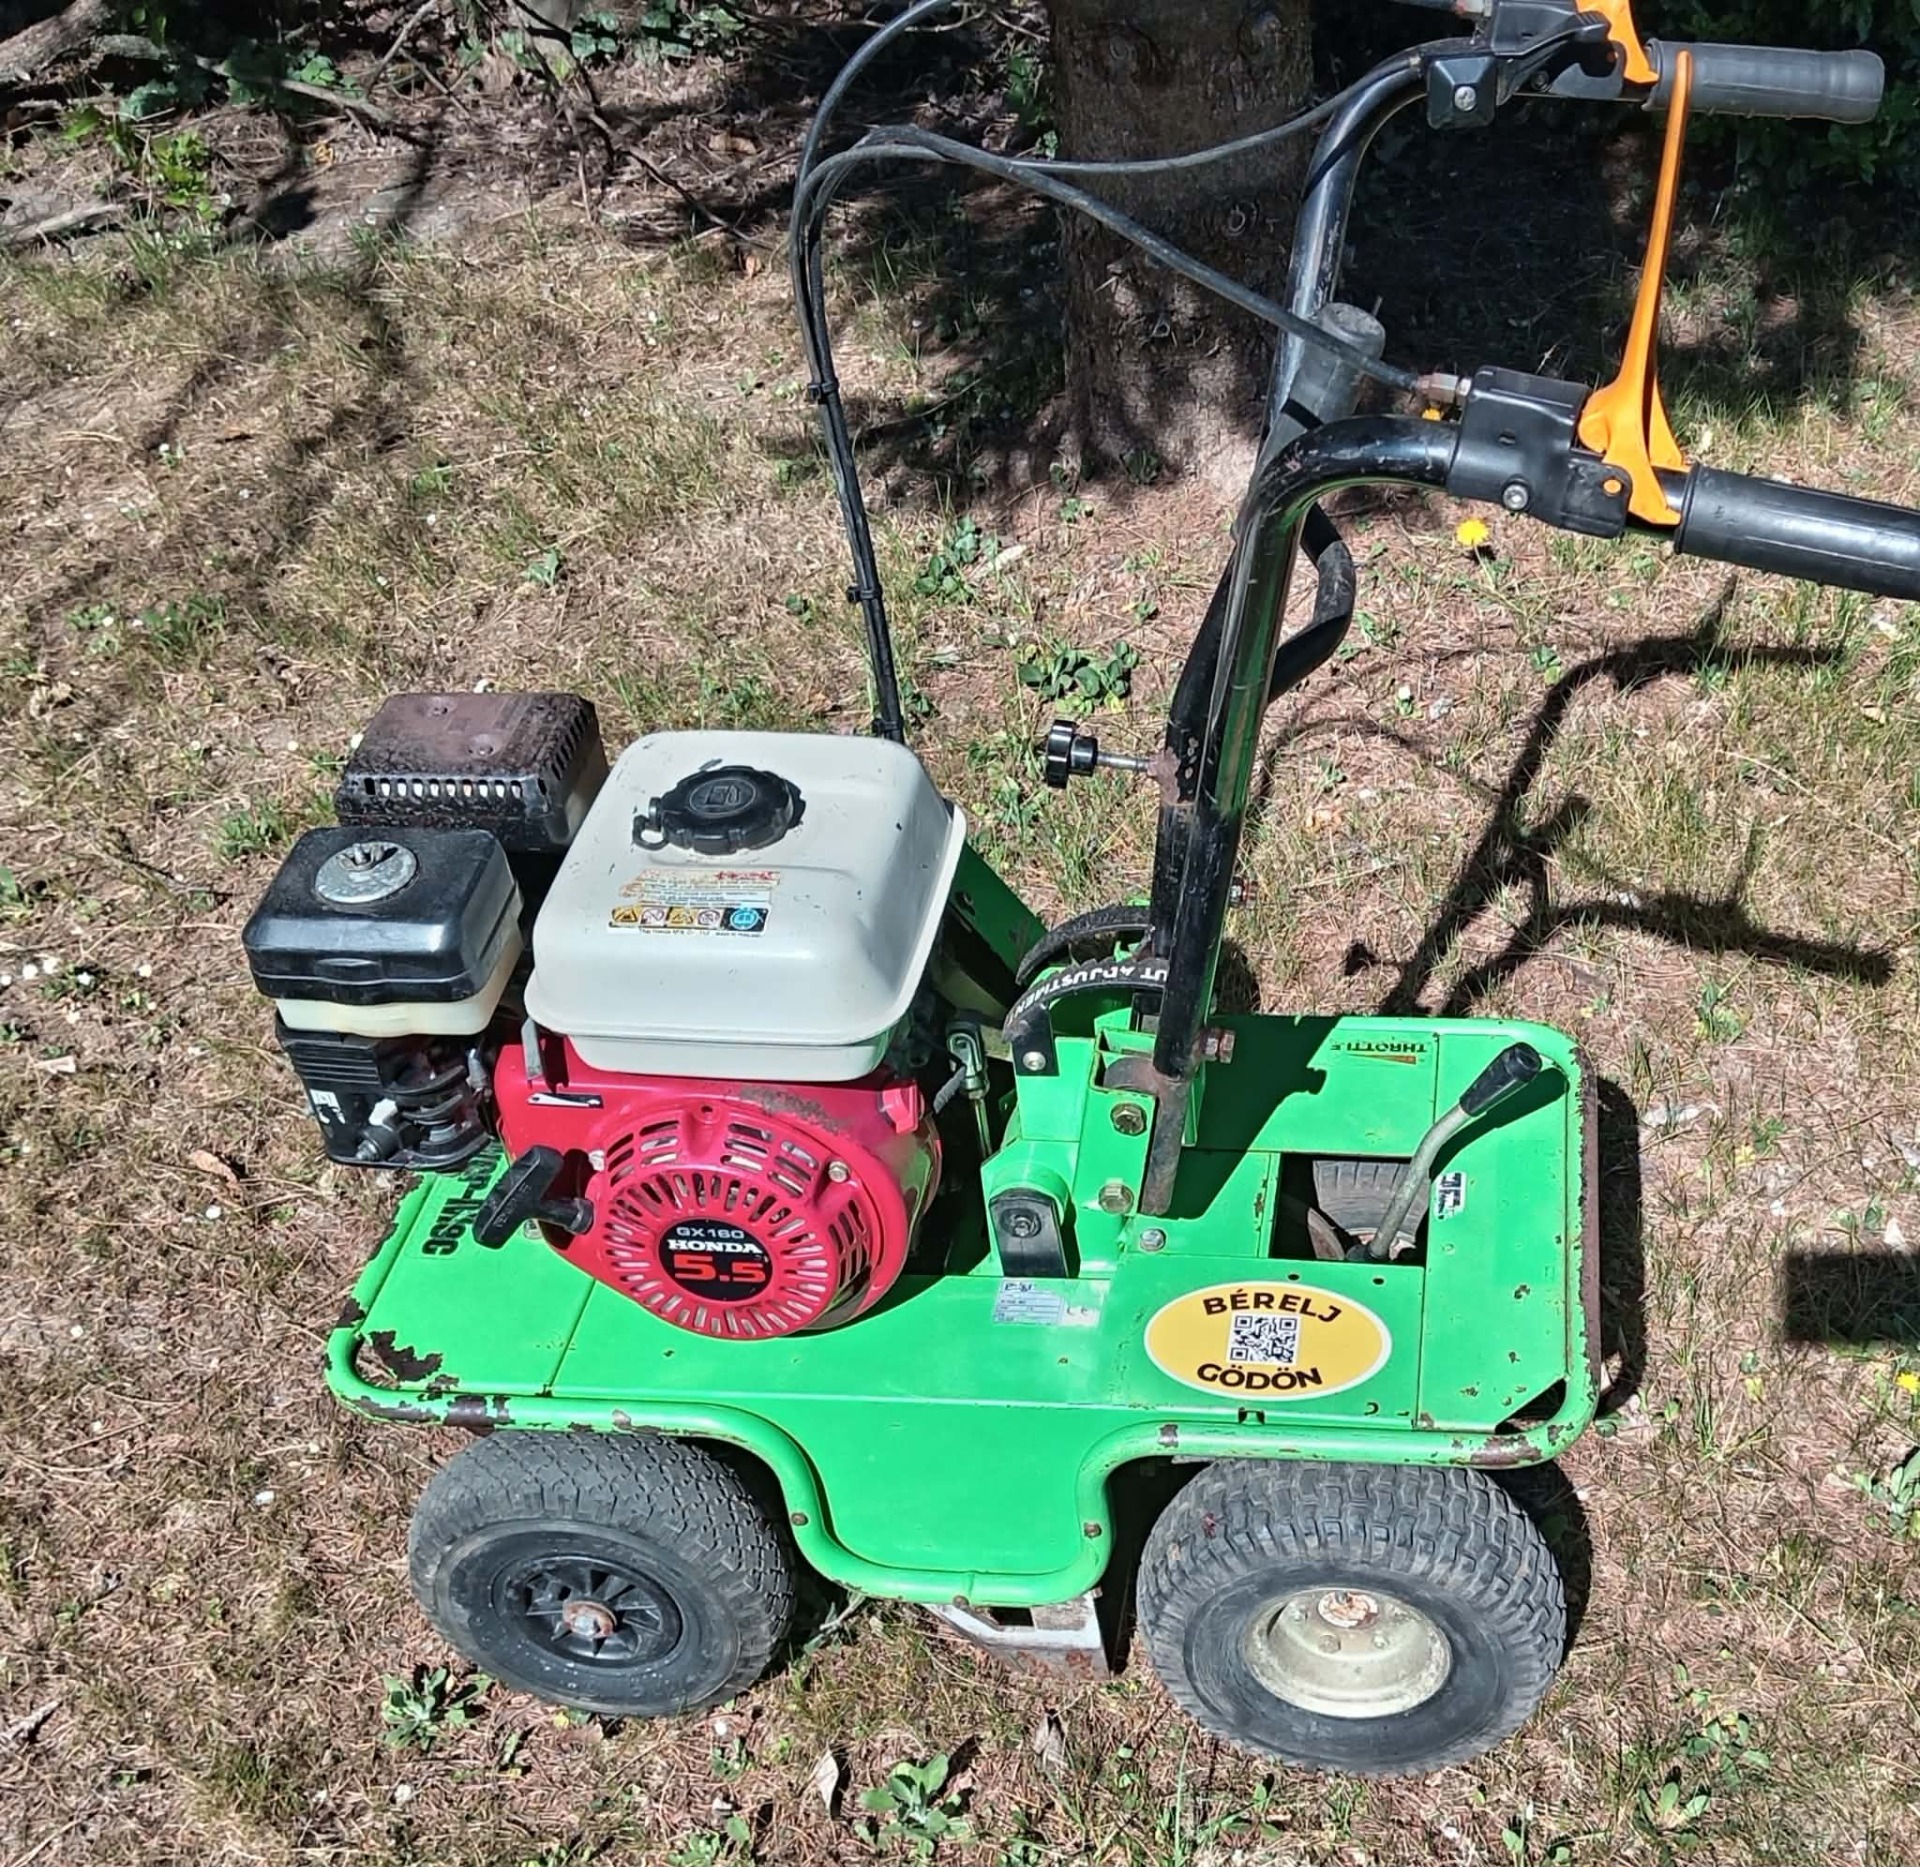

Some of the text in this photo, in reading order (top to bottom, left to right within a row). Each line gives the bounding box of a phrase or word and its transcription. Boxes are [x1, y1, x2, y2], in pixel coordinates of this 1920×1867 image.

[1140, 967, 1169, 982] UT
[666, 1238, 763, 1255] HONDA
[673, 1254, 766, 1284] 5.5
[1202, 1288, 1343, 1324] BÉRELJ
[1197, 1362, 1324, 1390] GÖDÖN
